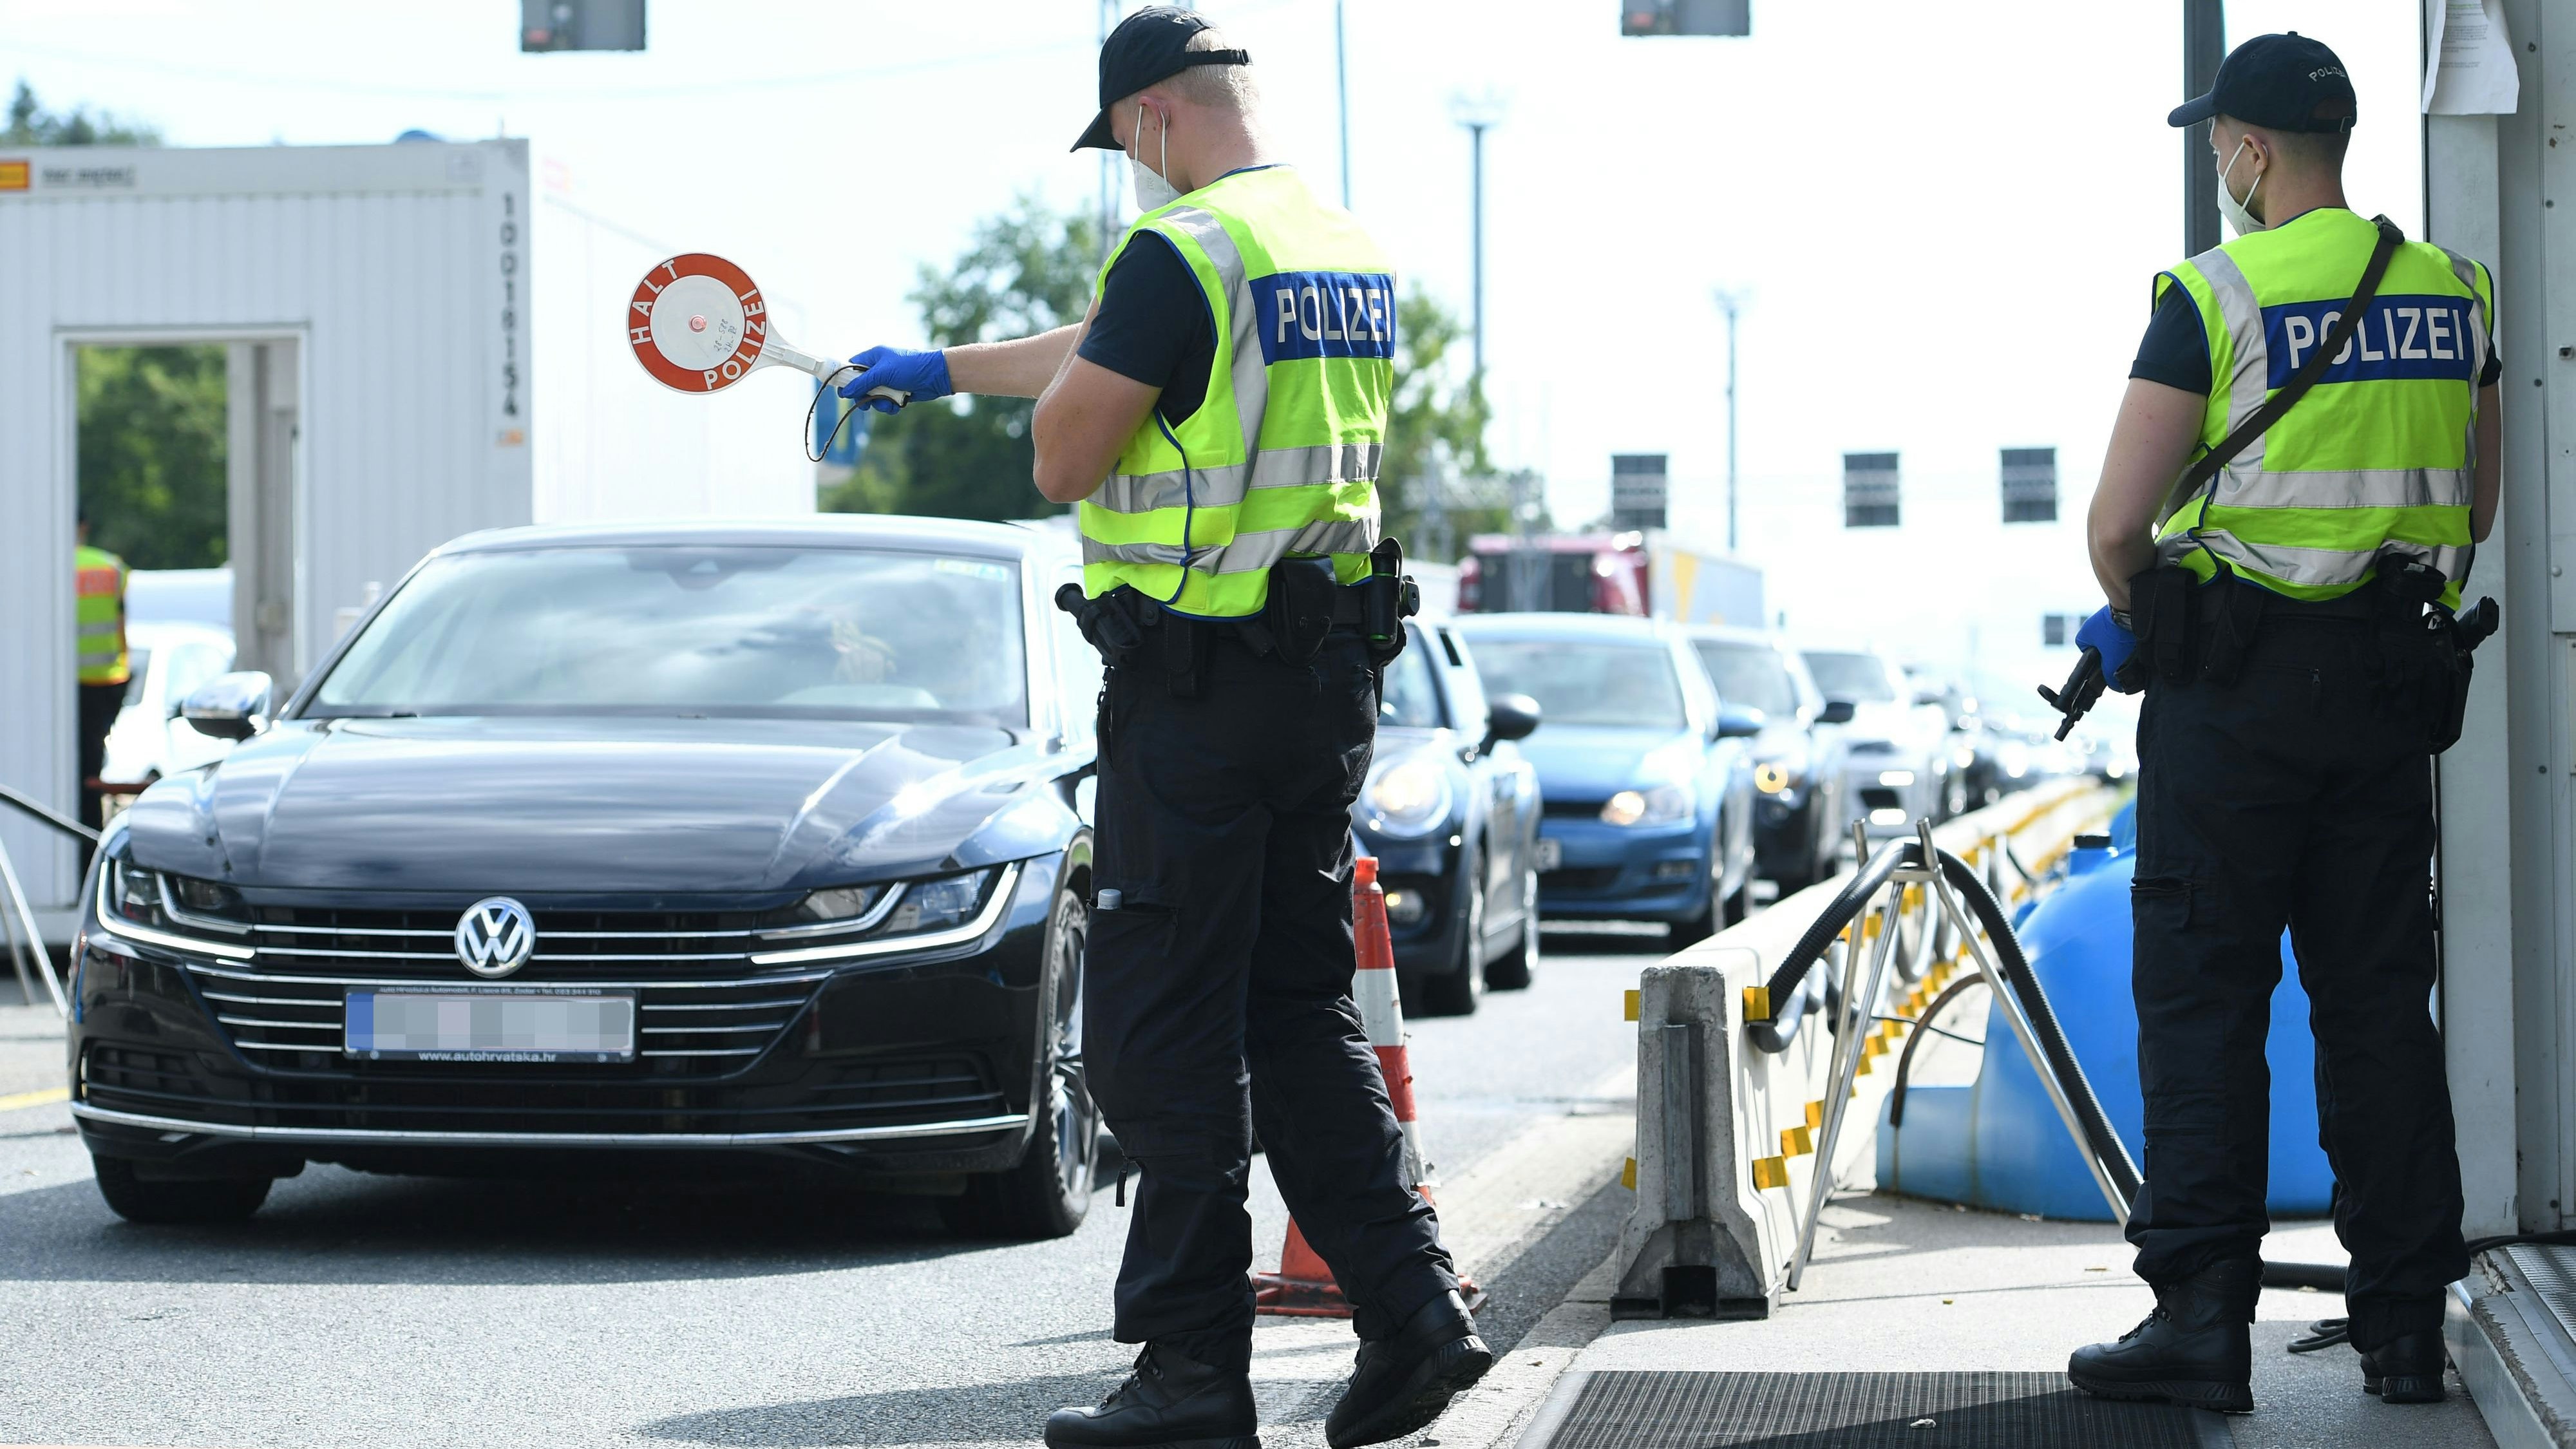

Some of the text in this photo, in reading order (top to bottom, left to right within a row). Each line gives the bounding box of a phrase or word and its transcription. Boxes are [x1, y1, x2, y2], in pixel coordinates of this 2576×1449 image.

[630, 260, 677, 344] HALT
[1276, 286, 1391, 343] POLIZEI
[703, 289, 765, 390] POLIZEI
[2285, 307, 2464, 369] POLIZEI
[419, 1051, 556, 1062] www.autohrvatska.hr
